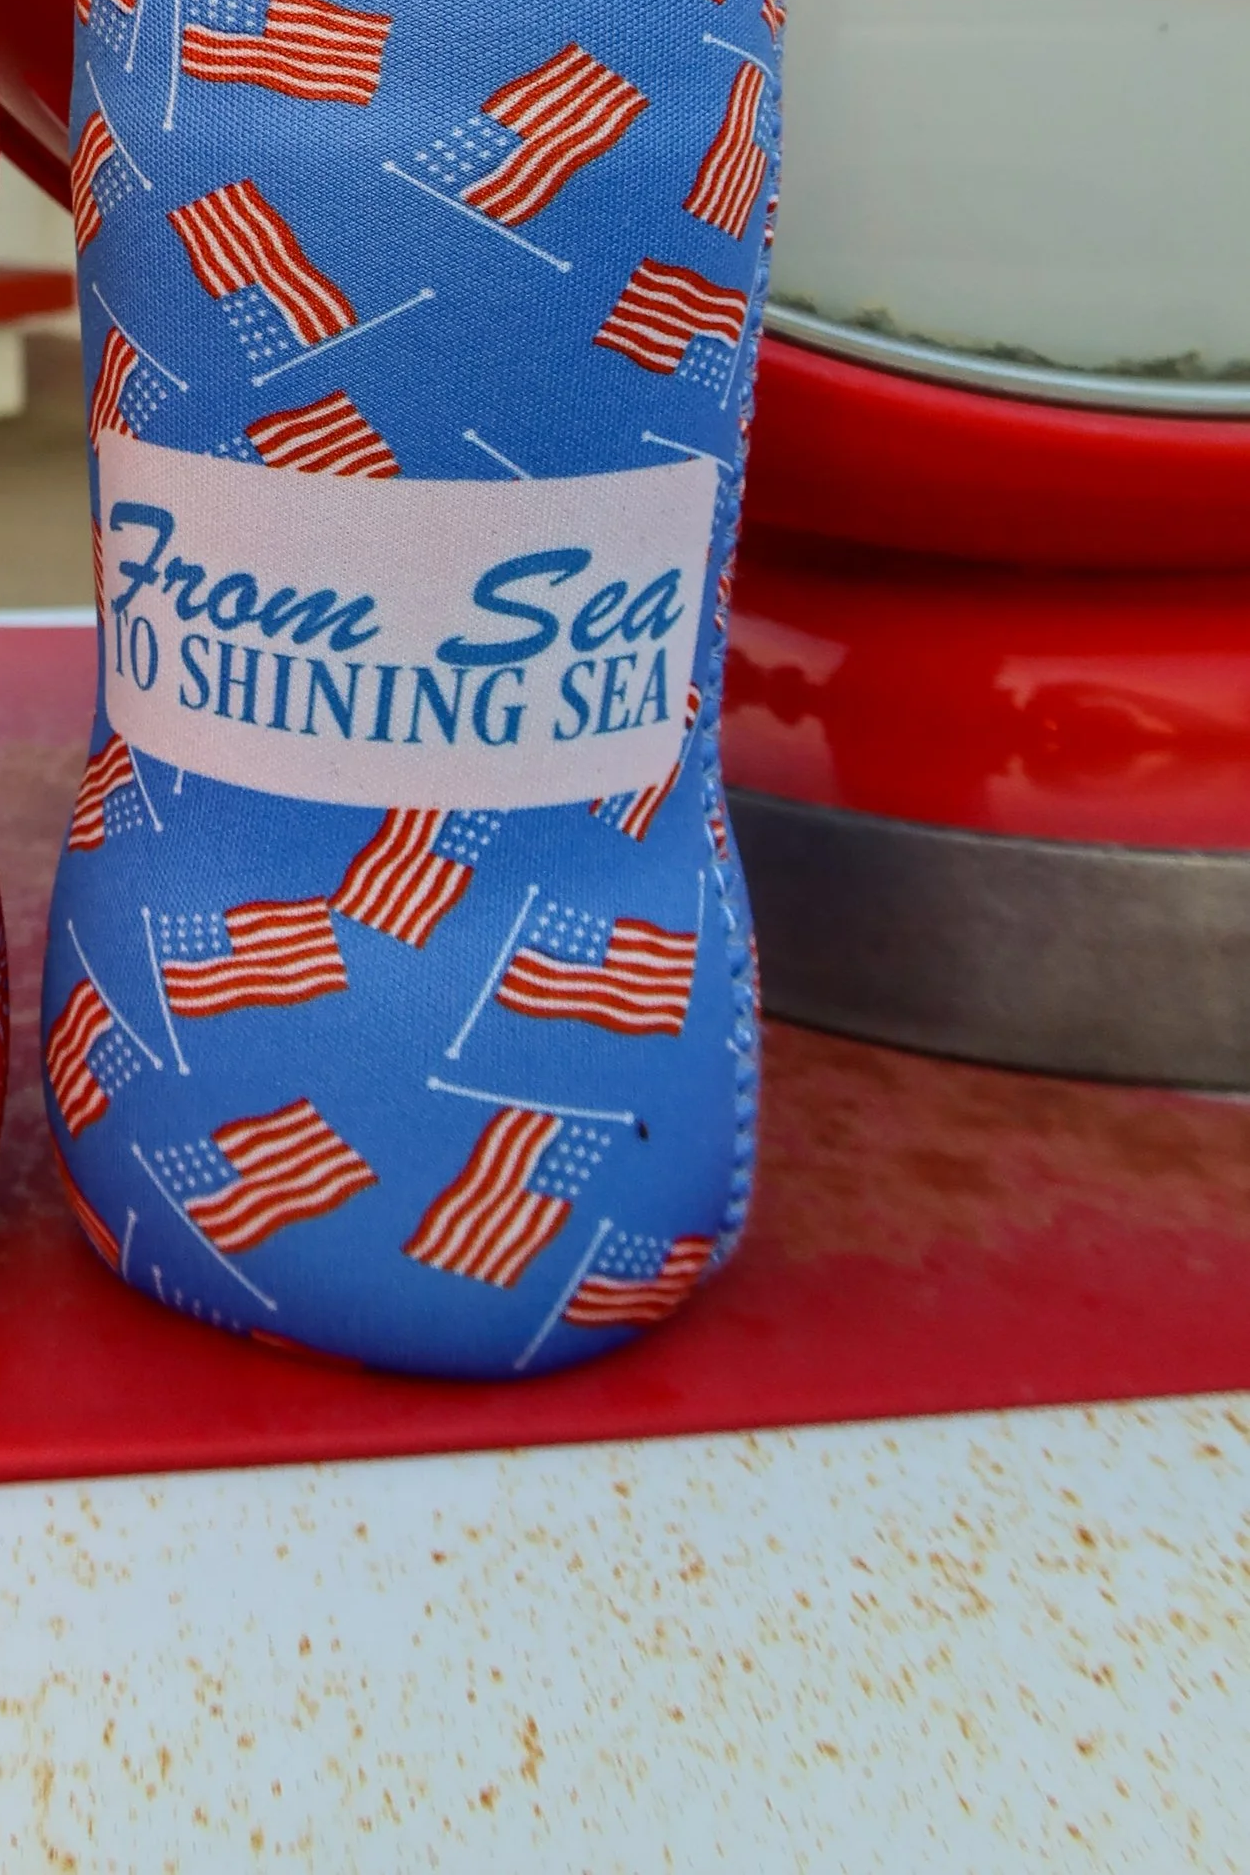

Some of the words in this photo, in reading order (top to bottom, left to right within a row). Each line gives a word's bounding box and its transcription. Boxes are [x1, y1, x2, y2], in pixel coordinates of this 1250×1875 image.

[110, 501, 378, 653] From
[437, 548, 686, 667] Sea
[111, 607, 159, 692] TO
[179, 633, 526, 747] SHINING
[553, 648, 670, 741] SEA
